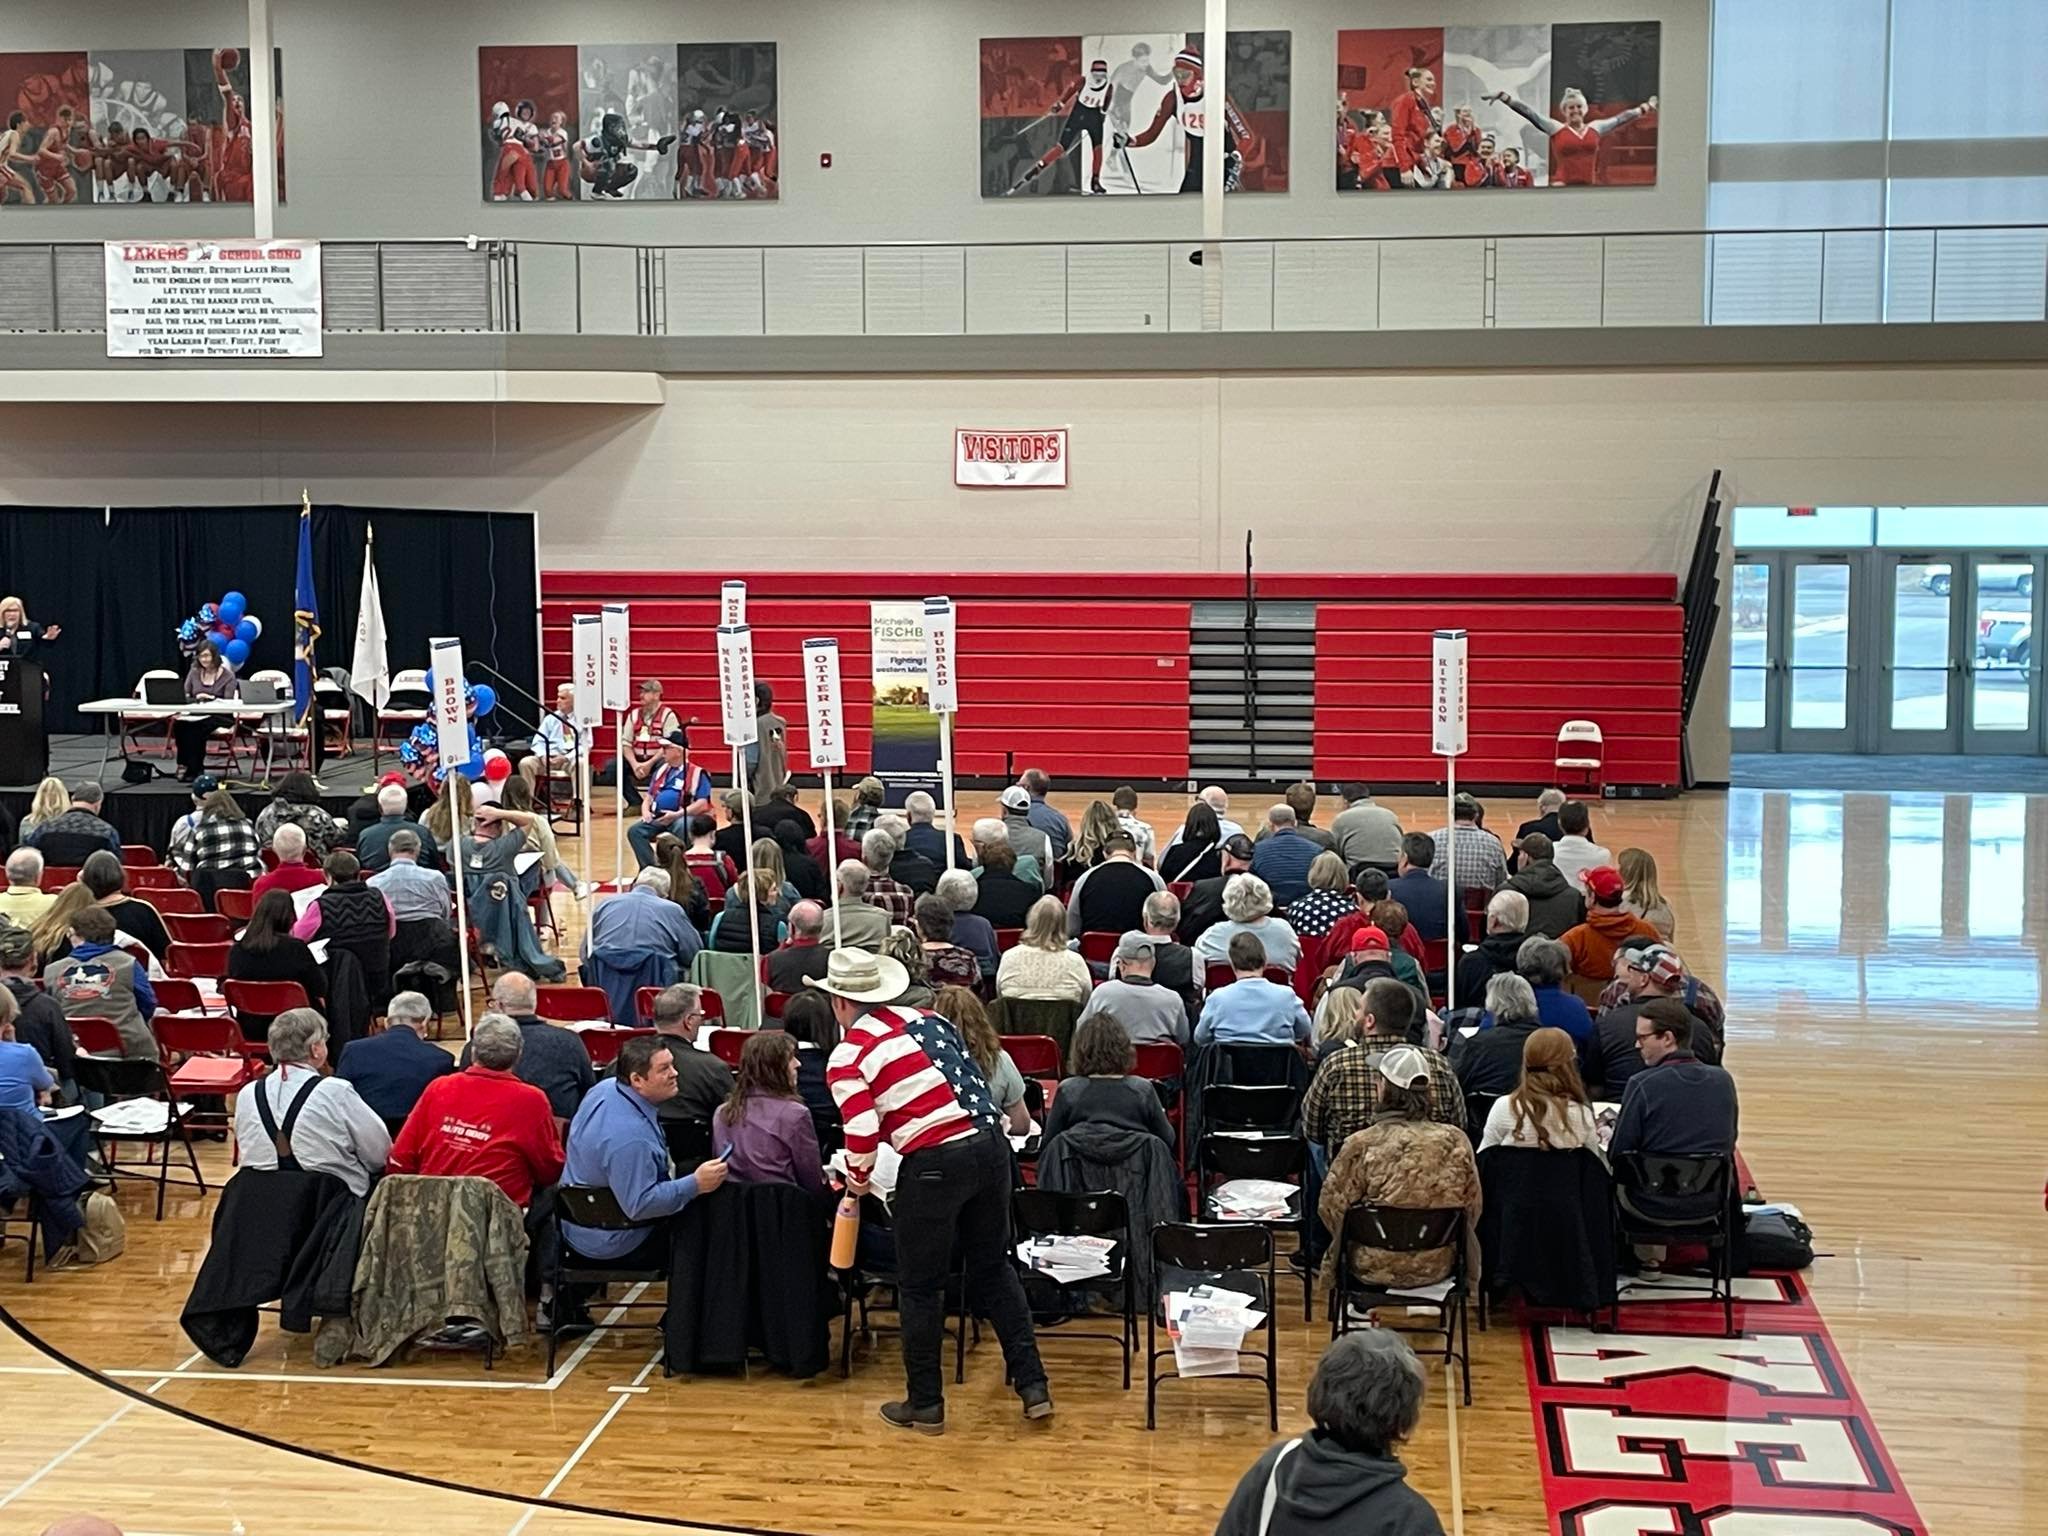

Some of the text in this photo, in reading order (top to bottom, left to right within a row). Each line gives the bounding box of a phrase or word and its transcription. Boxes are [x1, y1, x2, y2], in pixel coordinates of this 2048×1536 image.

[122, 246, 302, 262] LAKERS SCHOOL SONG
[152, 297, 168, 305] AND
[163, 287, 177, 295] LET
[180, 287, 206, 295] EVERY
[962, 433, 1061, 463] VISITORS
[727, 598, 739, 625] MORR
[874, 617, 914, 626] Michelle
[873, 626, 924, 638] FISCHB
[586, 654, 596, 687] LYON
[609, 637, 618, 675] GRANT
[890, 656, 923, 666] Fighting
[933, 630, 948, 686] HUBBARD
[721, 647, 734, 719] MARSHALL
[738, 647, 752, 718] MARSHALL
[814, 655, 830, 702] OTTER
[1438, 658, 1448, 723] KITTSON
[444, 678, 460, 724] BROWN
[818, 709, 833, 746] TAIL
